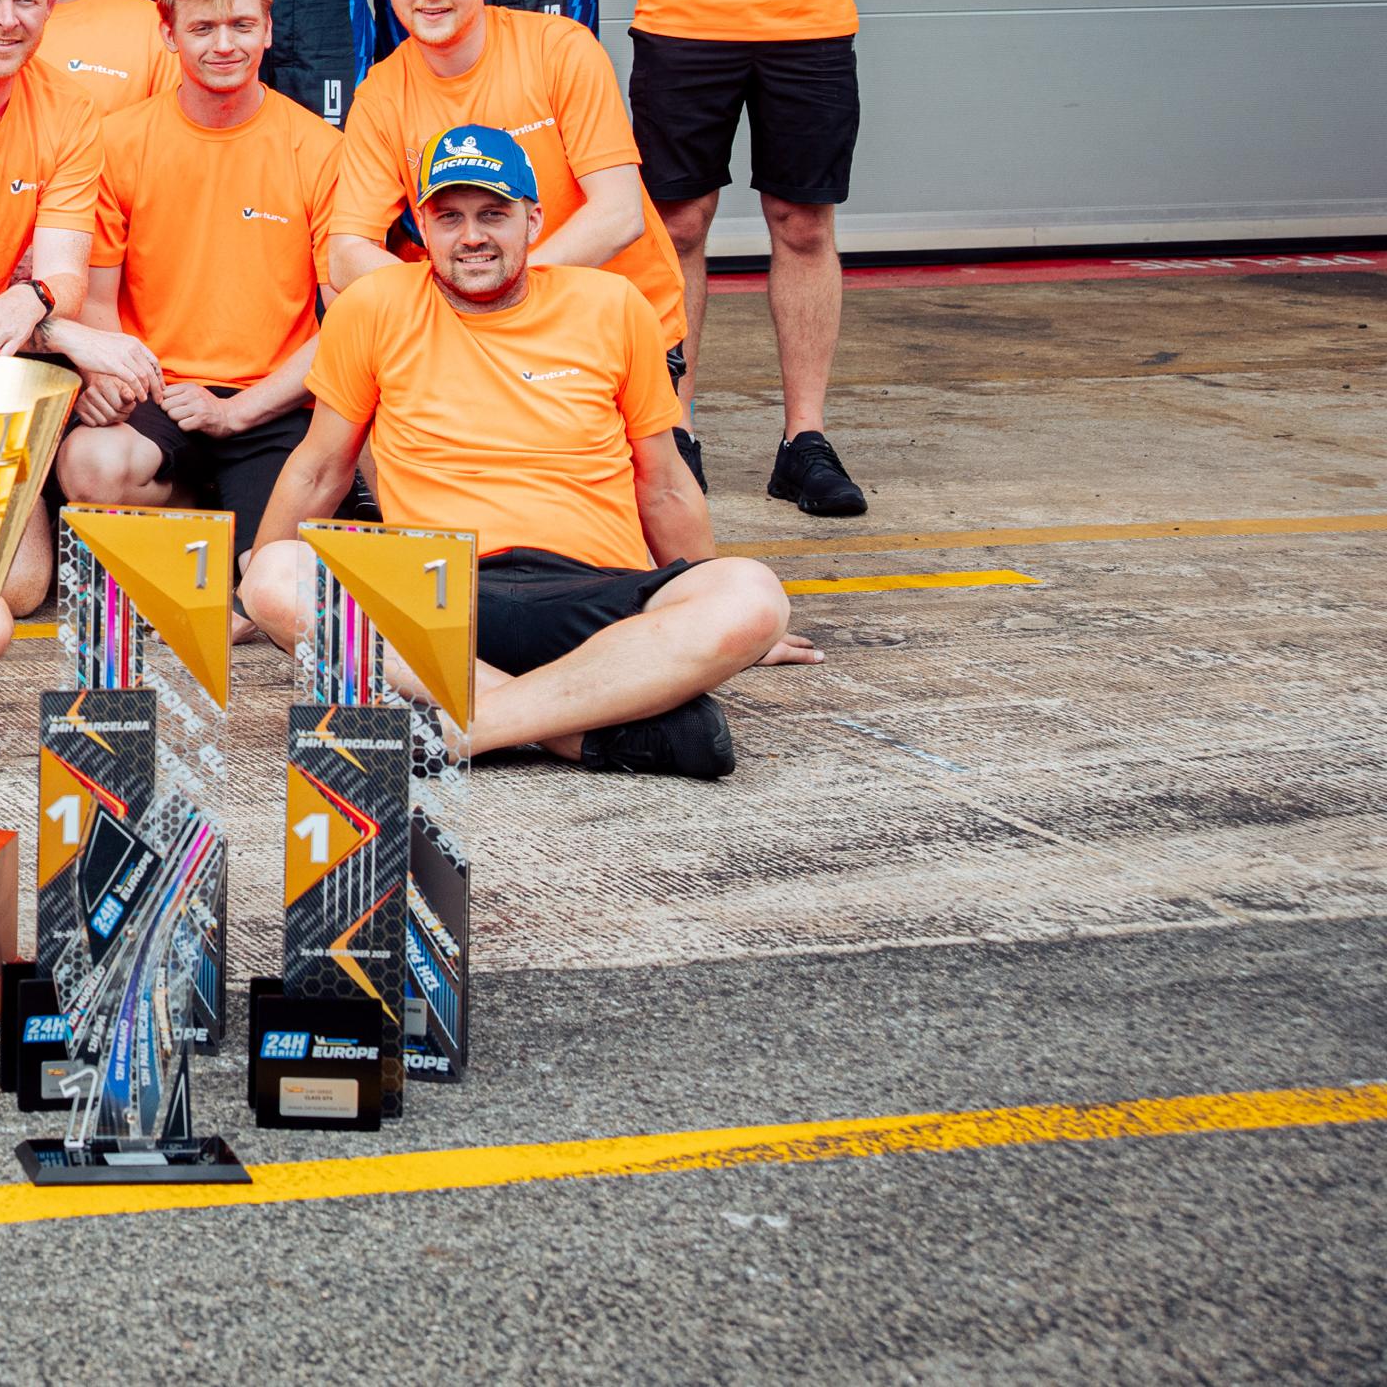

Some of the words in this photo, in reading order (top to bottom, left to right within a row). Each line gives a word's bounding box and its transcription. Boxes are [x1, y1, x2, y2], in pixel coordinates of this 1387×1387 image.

[68, 59, 128, 79] Venture
[431, 158, 503, 176] MICHELIN
[242, 207, 289, 223] Venture
[522, 367, 580, 382] Venture
[185, 540, 209, 589] 1
[422, 558, 448, 609] 1
[48, 721, 74, 734] 24H
[76, 720, 150, 733] BARCELONA
[296, 737, 323, 748] 24H
[324, 738, 404, 750] BARCELONA
[46, 795, 80, 845] 1
[292, 813, 330, 863] 1
[119, 850, 154, 902] EUROPE
[93, 896, 120, 932] 24H
[77, 965, 106, 1010] MUGELLO
[28, 1017, 66, 1033] 24H
[138, 999, 149, 1040] RICARD
[26, 1033, 65, 1042] SERIES
[116, 1019, 130, 1062] MISANO
[267, 1034, 305, 1050] 24H
[140, 1040, 150, 1067] PAUL
[264, 1049, 303, 1058] SERIES
[312, 1045, 379, 1060] EUROPE
[115, 1062, 126, 1081] 12H
[140, 1067, 151, 1087] 12H
